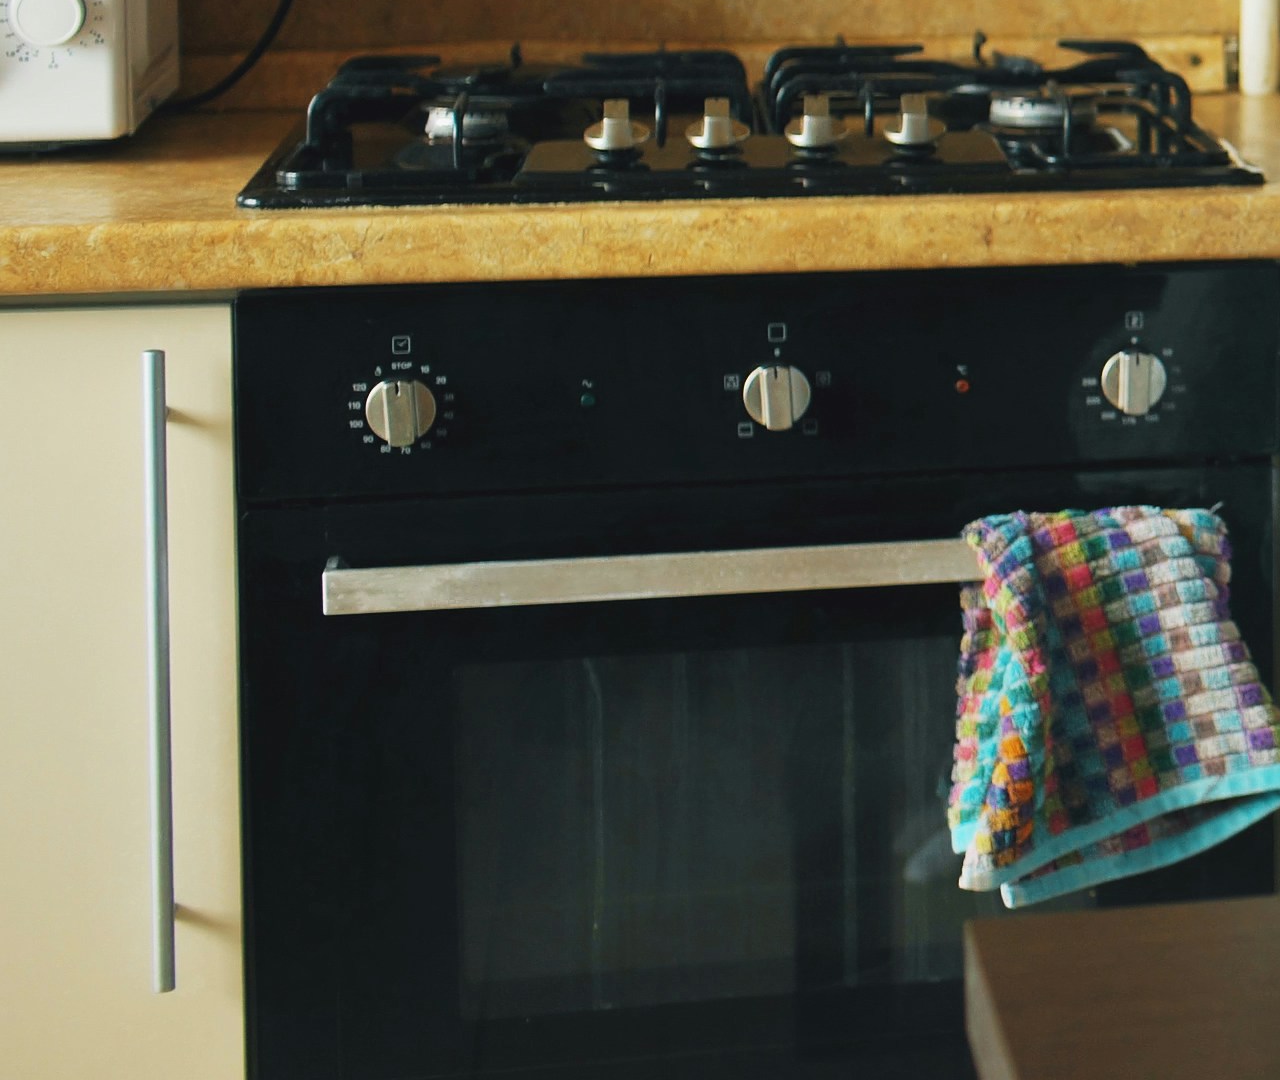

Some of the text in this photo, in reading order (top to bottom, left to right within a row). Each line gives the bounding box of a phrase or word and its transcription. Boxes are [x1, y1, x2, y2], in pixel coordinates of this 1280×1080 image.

[391, 362, 412, 370] STOP
[421, 365, 430, 374] 10
[436, 376, 447, 385] 20
[352, 383, 366, 392] 120
[348, 401, 361, 410] 110
[349, 420, 363, 428] 100
[363, 435, 374, 443] 90
[380, 445, 391, 453] 80
[401, 446, 411, 455] 70
